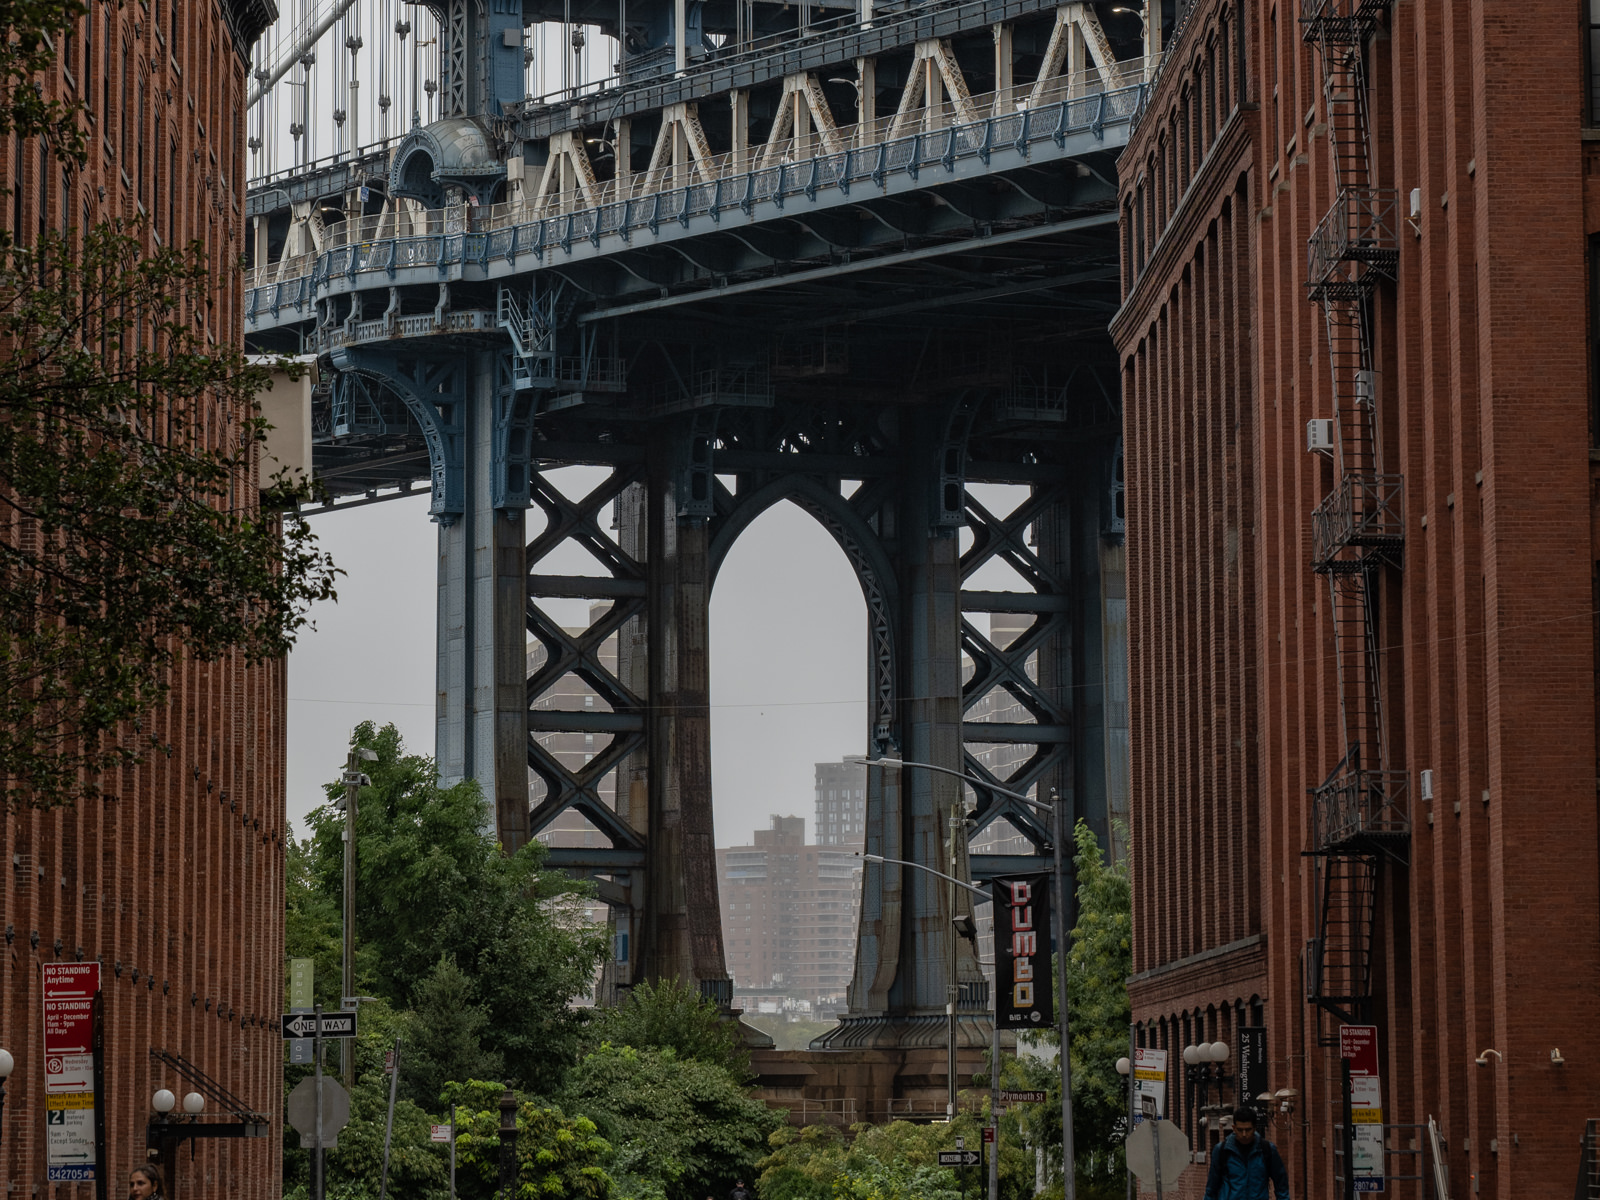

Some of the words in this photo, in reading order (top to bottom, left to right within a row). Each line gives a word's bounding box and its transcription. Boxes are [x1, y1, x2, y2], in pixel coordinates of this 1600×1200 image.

[1010, 880, 1037, 1008] DUMBO
[46, 967, 56, 975] NO
[57, 966, 90, 975] STANDING
[47, 976, 74, 985] Anytime
[296, 963, 304, 1005] Smack
[46, 1002, 56, 1011] NO
[57, 1002, 90, 1010] STANDING
[63, 1013, 90, 1021] December
[63, 1020, 75, 1028] 9pm
[294, 1021, 315, 1031] ONE
[324, 1019, 347, 1030] WAY
[55, 1027, 68, 1036] Days
[1350, 1028, 1371, 1036] STANDING
[1241, 1033, 1250, 1043] 25
[1240, 1045, 1250, 1090] Washington
[1002, 1092, 1035, 1101] Plymouth
[1036, 1093, 1043, 1101] St
[52, 1110, 61, 1124] 2
[66, 1130, 77, 1138] 7pm
[69, 1137, 87, 1145] Sunday
[50, 1169, 83, 1180] 342705
[1353, 1181, 1370, 1190] 2807
